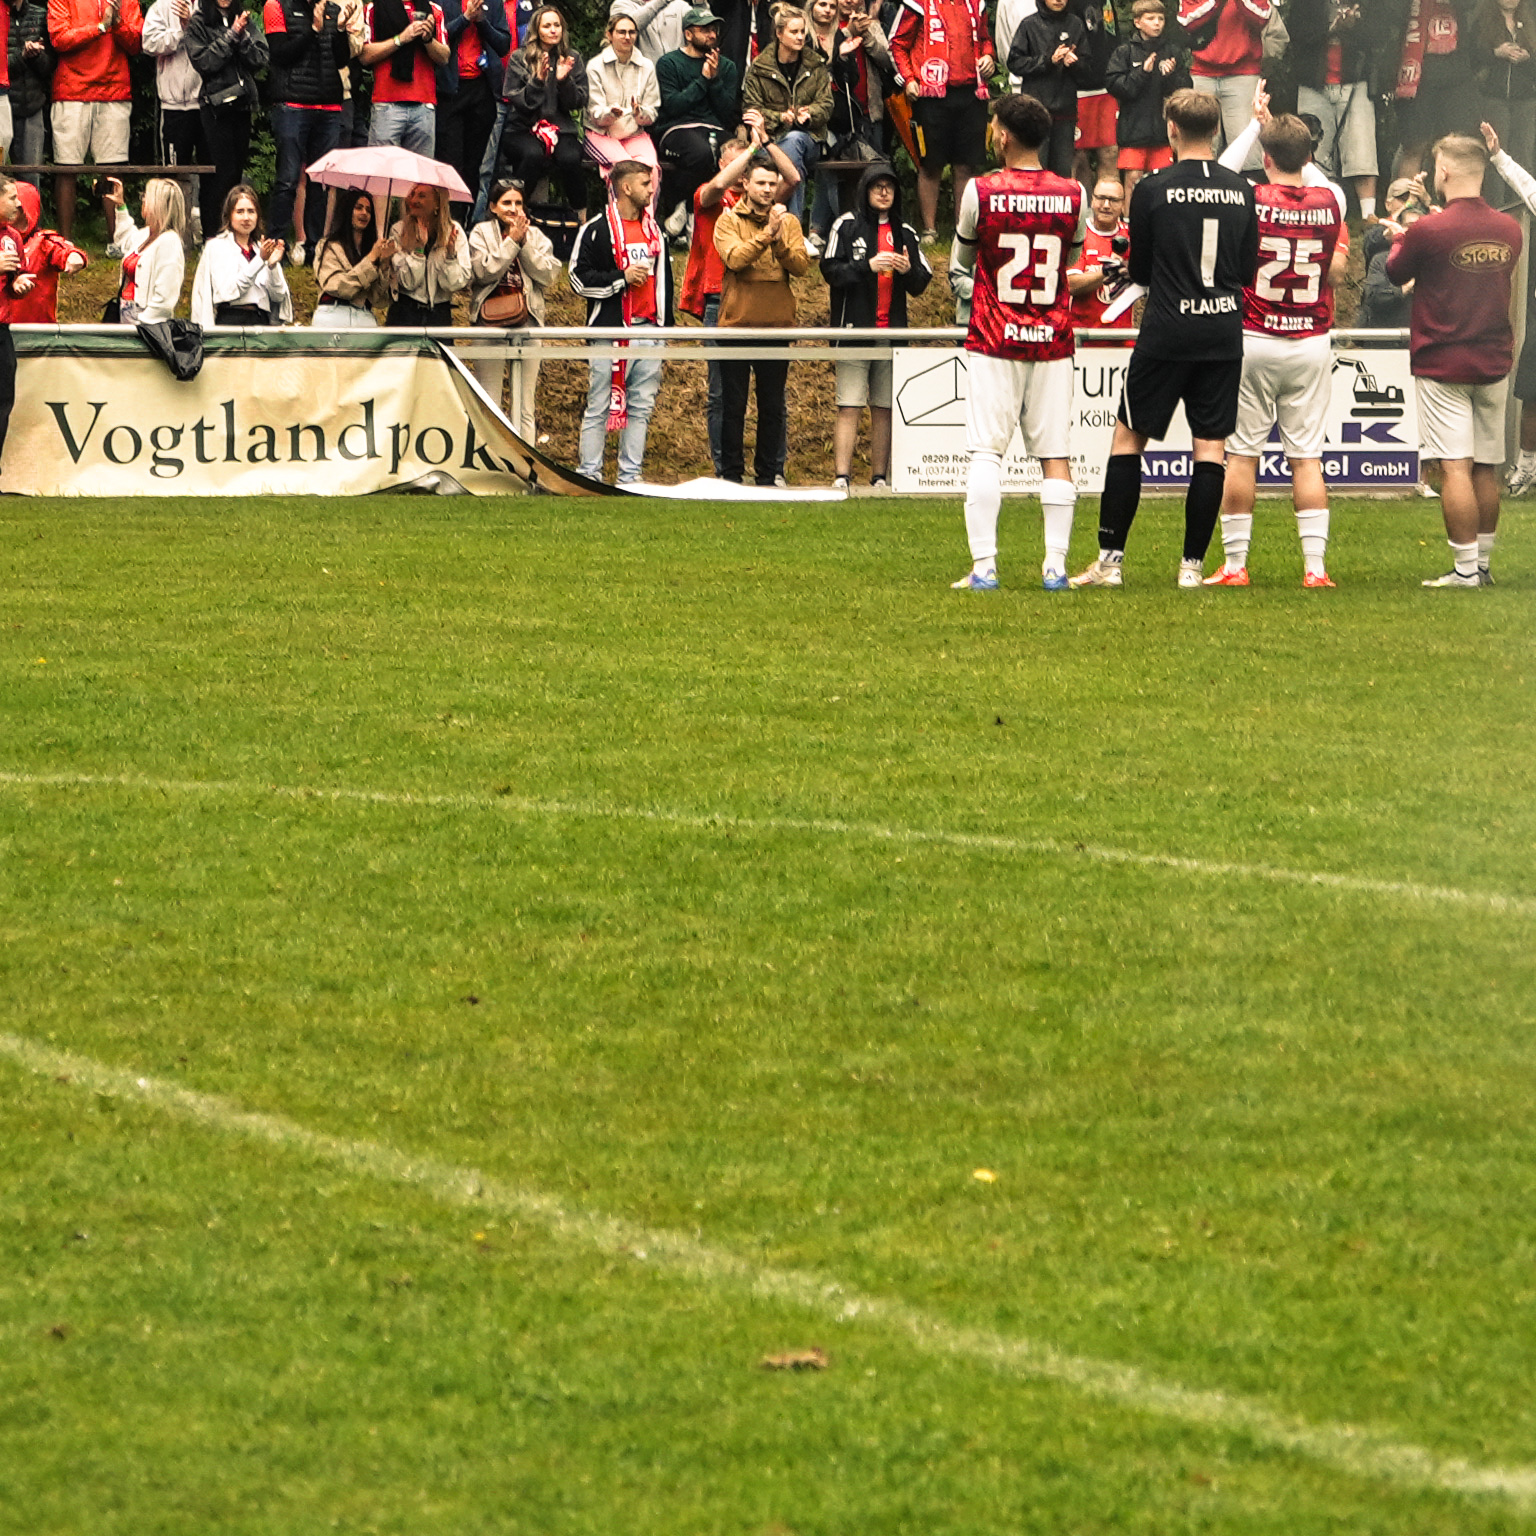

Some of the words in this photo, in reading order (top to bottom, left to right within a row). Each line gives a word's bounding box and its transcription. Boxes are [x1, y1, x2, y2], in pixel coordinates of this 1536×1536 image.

[989, 195, 1007, 213] FC
[1008, 195, 1073, 213] FORTUNA
[1166, 188, 1186, 204] FC
[1186, 188, 1245, 206] FORTUNA
[1271, 207, 1335, 225] FORTUNA
[1201, 218, 1219, 287] 1
[997, 233, 1062, 305] 23
[1255, 237, 1323, 303] 25
[1180, 295, 1237, 314] PLAUEN
[1080, 410, 1117, 427] Kölb
[45, 398, 538, 483] Vogtlandpok
[922, 454, 949, 464] 08209
[952, 454, 971, 464] Reb
[1007, 467, 1024, 475] Fax
[1360, 461, 1409, 476] GmbH
